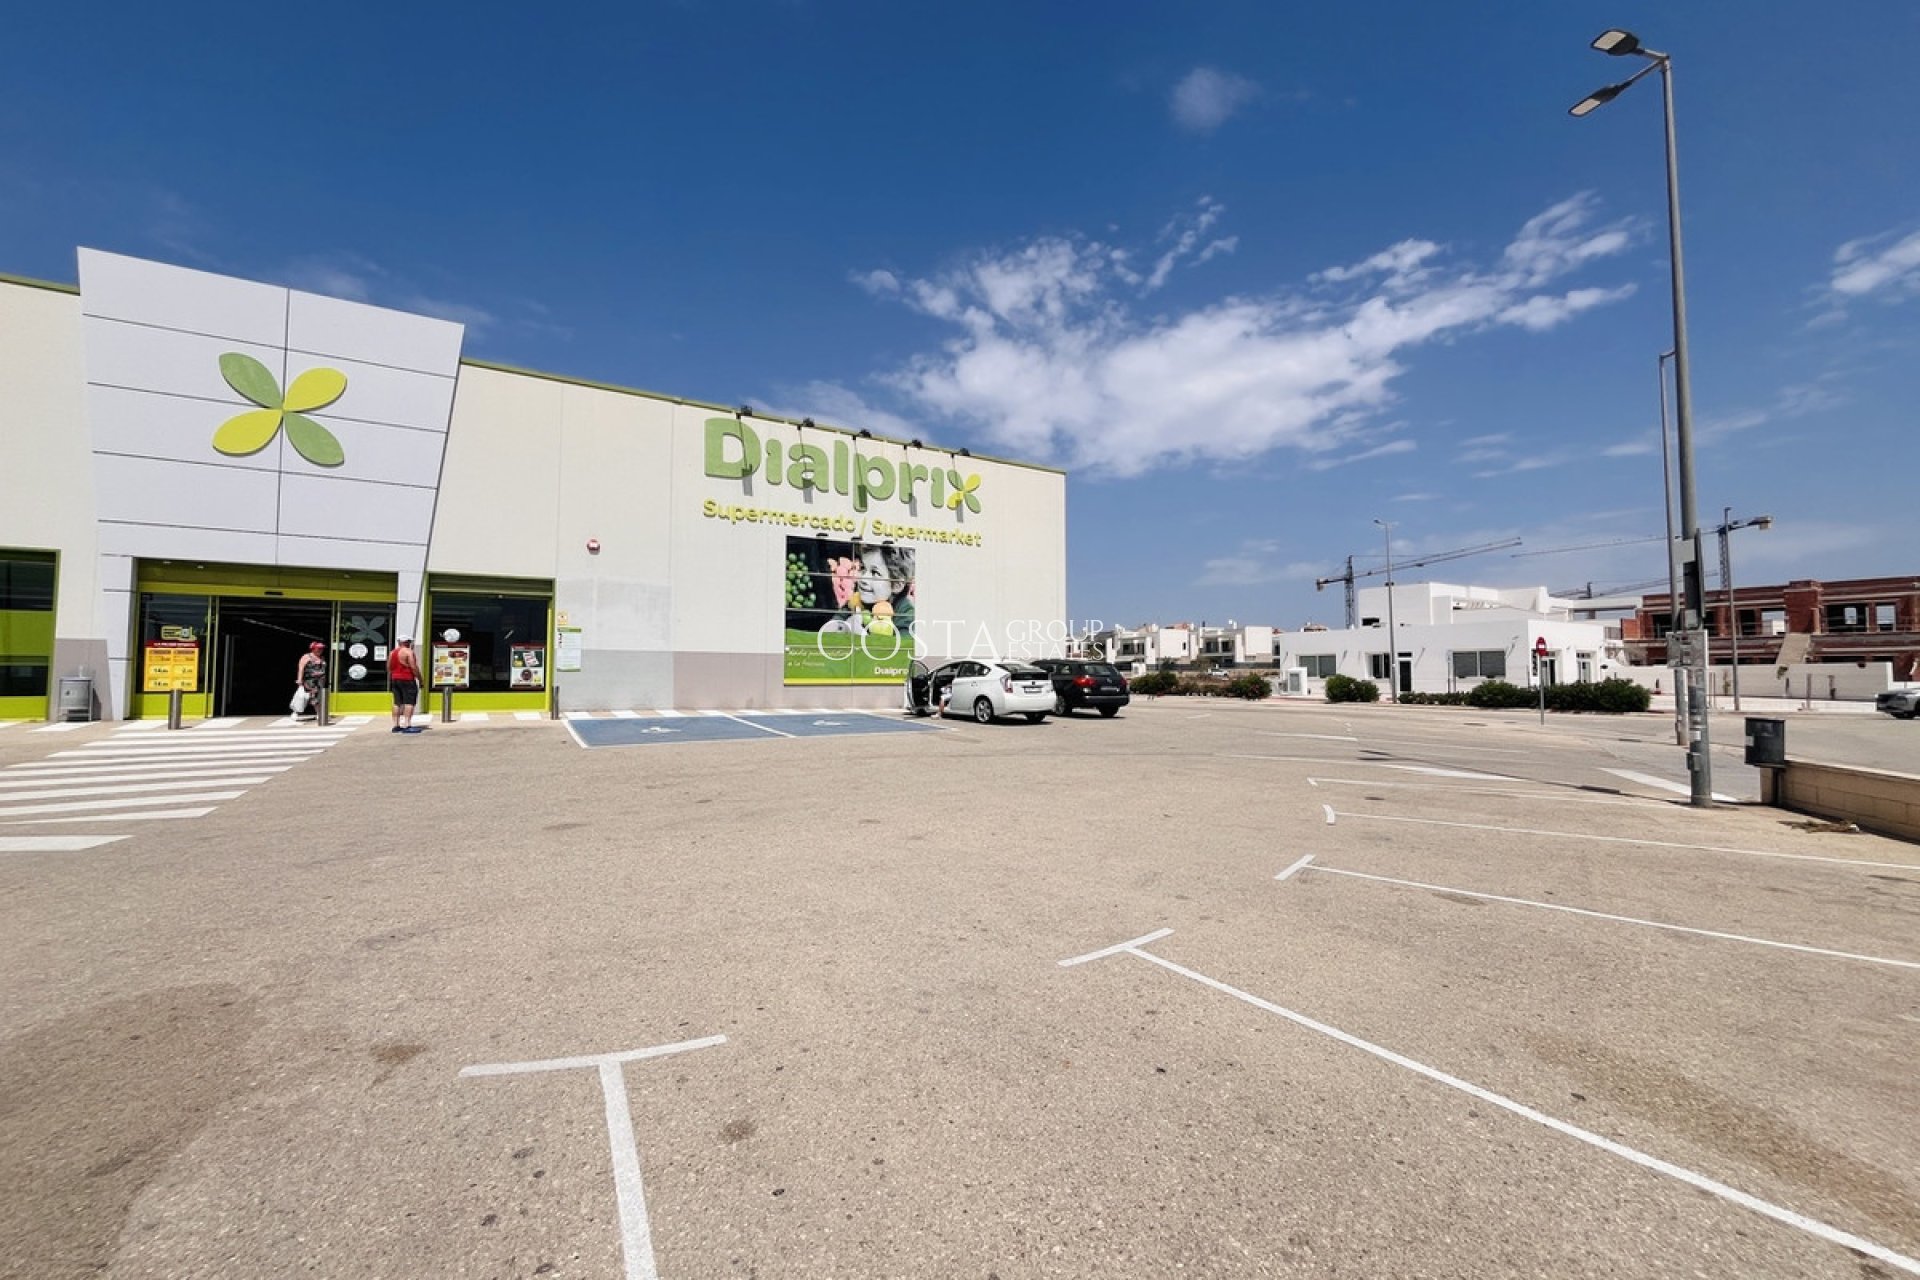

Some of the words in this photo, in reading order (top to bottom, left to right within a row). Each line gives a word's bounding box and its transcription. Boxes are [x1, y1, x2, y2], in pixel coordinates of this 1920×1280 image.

[704, 417, 982, 514] Dialprix
[703, 500, 857, 534] Supermercado
[872, 519, 982, 547] Supermarket
